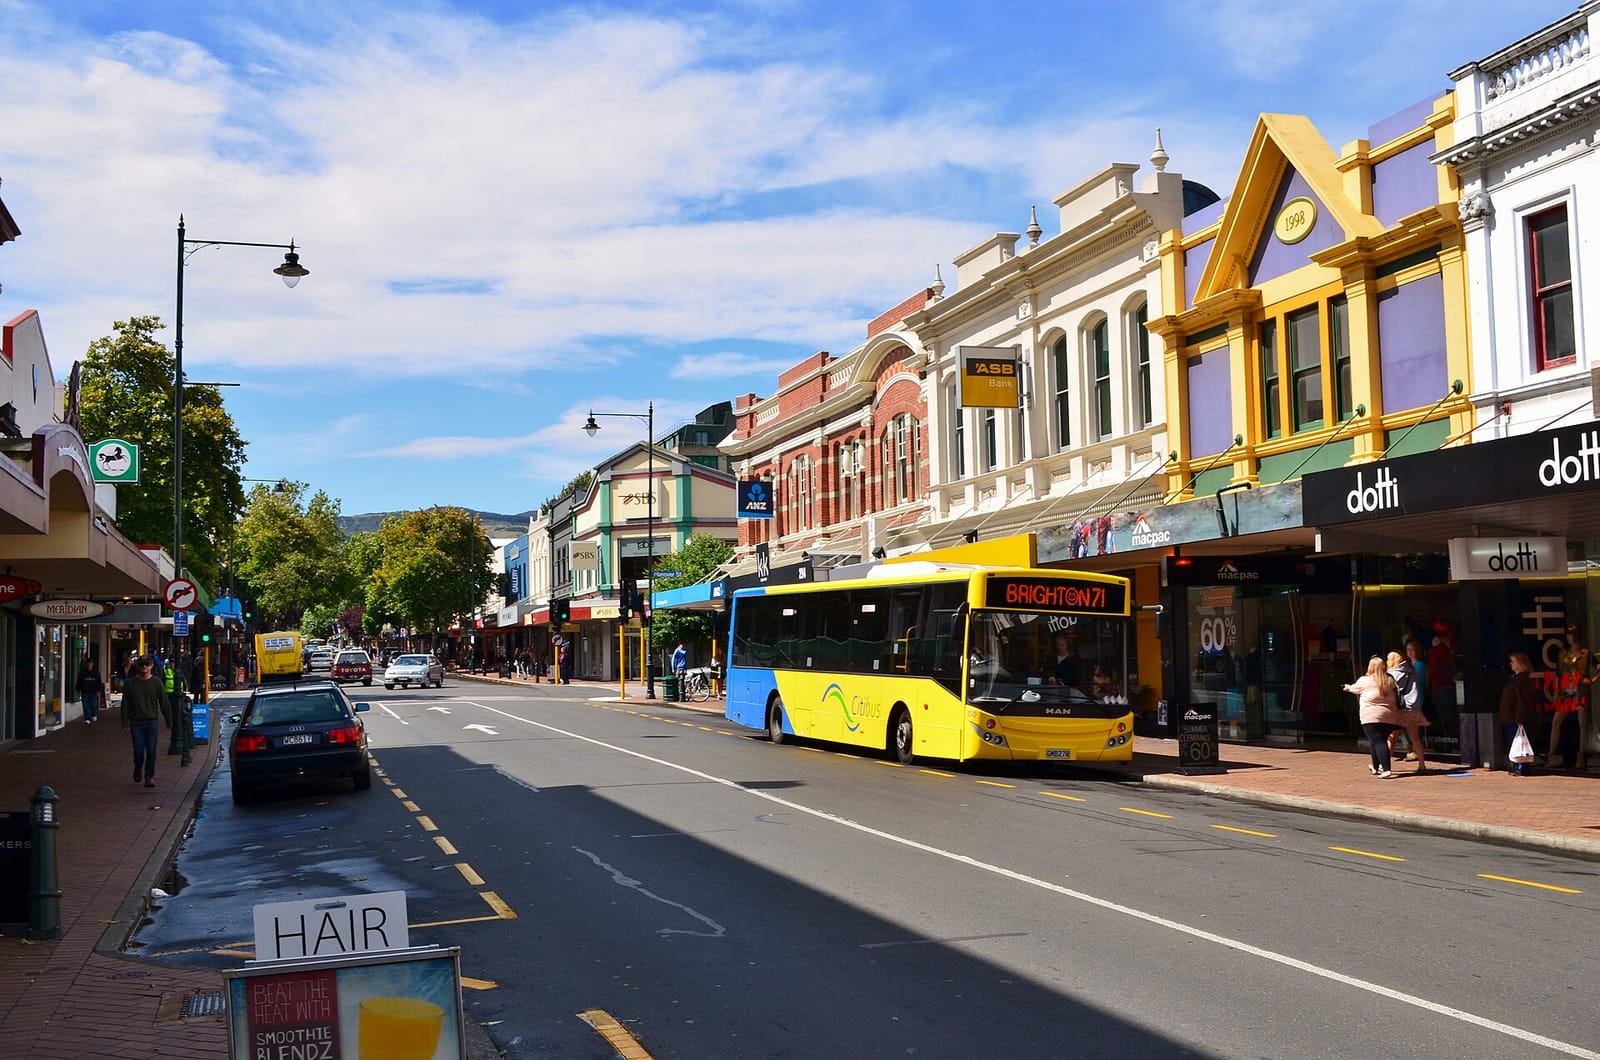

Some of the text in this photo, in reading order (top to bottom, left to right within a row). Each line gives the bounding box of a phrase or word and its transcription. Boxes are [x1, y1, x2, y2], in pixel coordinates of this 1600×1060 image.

[1285, 210, 1305, 232] 1998
[975, 362, 1014, 375] ASB
[989, 379, 1013, 388] Bank
[1346, 467, 1399, 514] dotti
[745, 501, 767, 510] ANZ
[1131, 530, 1170, 547] macpac
[579, 551, 595, 560] SBS
[1488, 542, 1537, 572] dotti
[511, 568, 520, 593] GALLERY
[1216, 570, 1260, 580] macpac
[1091, 587, 1105, 608] 71
[46, 602, 87, 614] MERIDIAN
[851, 695, 881, 719] Citibus
[1045, 708, 1071, 717] MAN
[1183, 713, 1213, 721] macpac
[1190, 742, 1210, 761] 60
[274, 906, 390, 959] HAIR
[253, 977, 329, 1005] BEAT THE
[255, 999, 332, 1025] HEAT WITH
[256, 1026, 333, 1046] SMOOTHIE
[257, 1041, 334, 1060] BLENDZ
